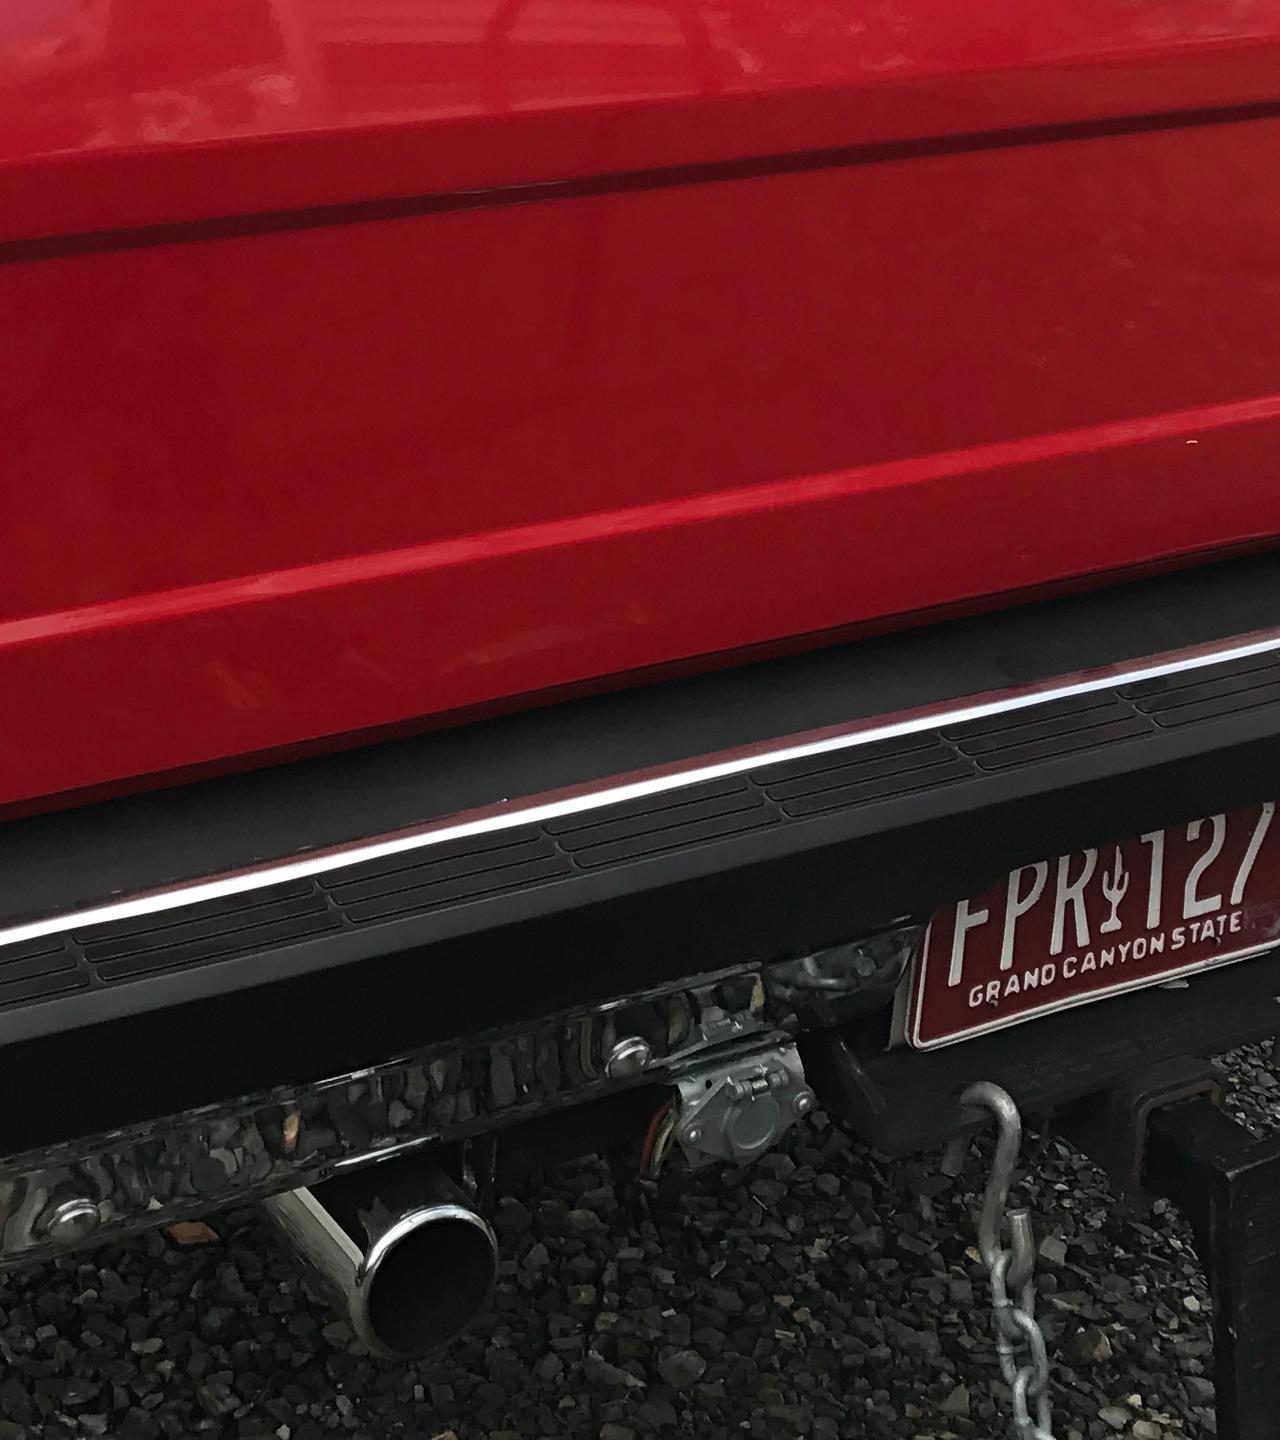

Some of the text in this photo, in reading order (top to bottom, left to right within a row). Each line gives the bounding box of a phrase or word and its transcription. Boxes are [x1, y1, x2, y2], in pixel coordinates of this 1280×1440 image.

[968, 911, 1243, 1008] GRAND CANYON STATE
